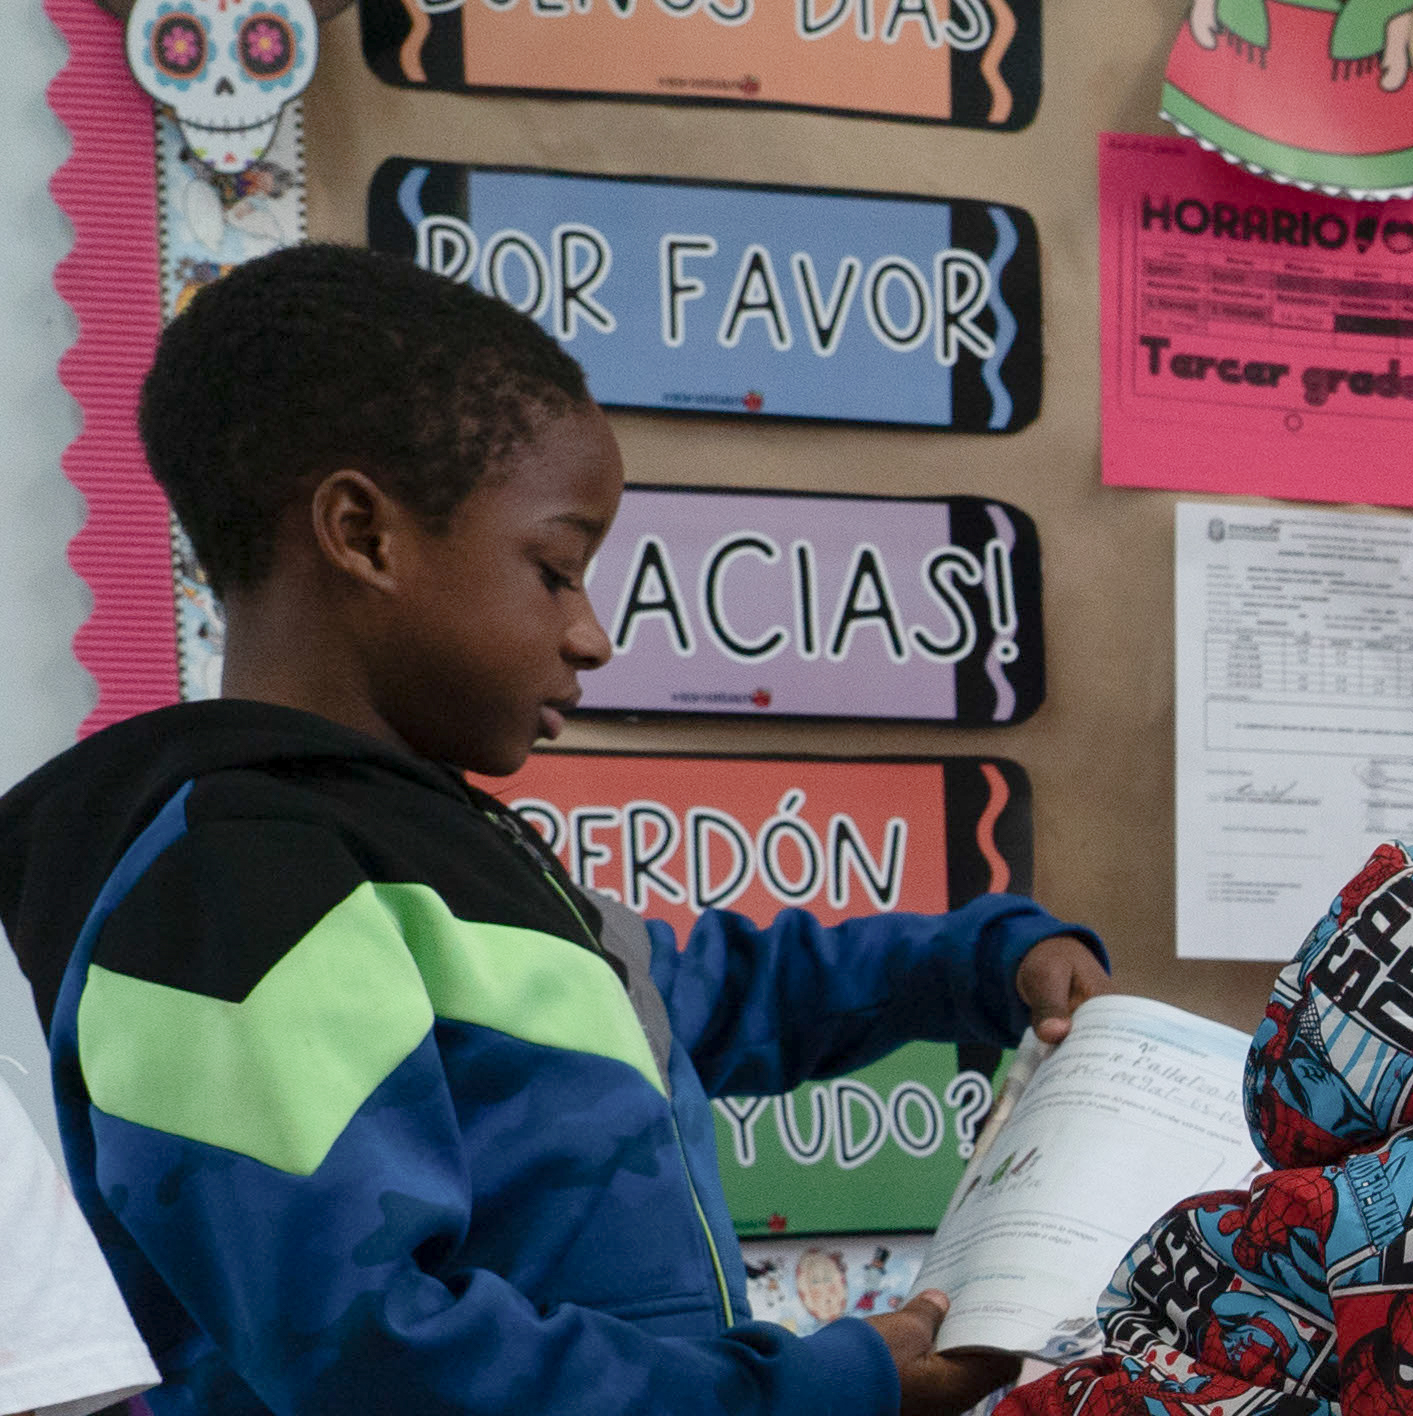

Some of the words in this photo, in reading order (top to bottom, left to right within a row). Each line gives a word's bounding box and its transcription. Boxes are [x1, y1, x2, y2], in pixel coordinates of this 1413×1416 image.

[1141, 195, 1349, 249] HORARIO
[418, 216, 615, 340] POR
[659, 232, 996, 364] FAVOR
[1140, 334, 1288, 388] Tercer
[610, 535, 1019, 665] ACIAS!
[714, 1070, 993, 1169] YUDO?
